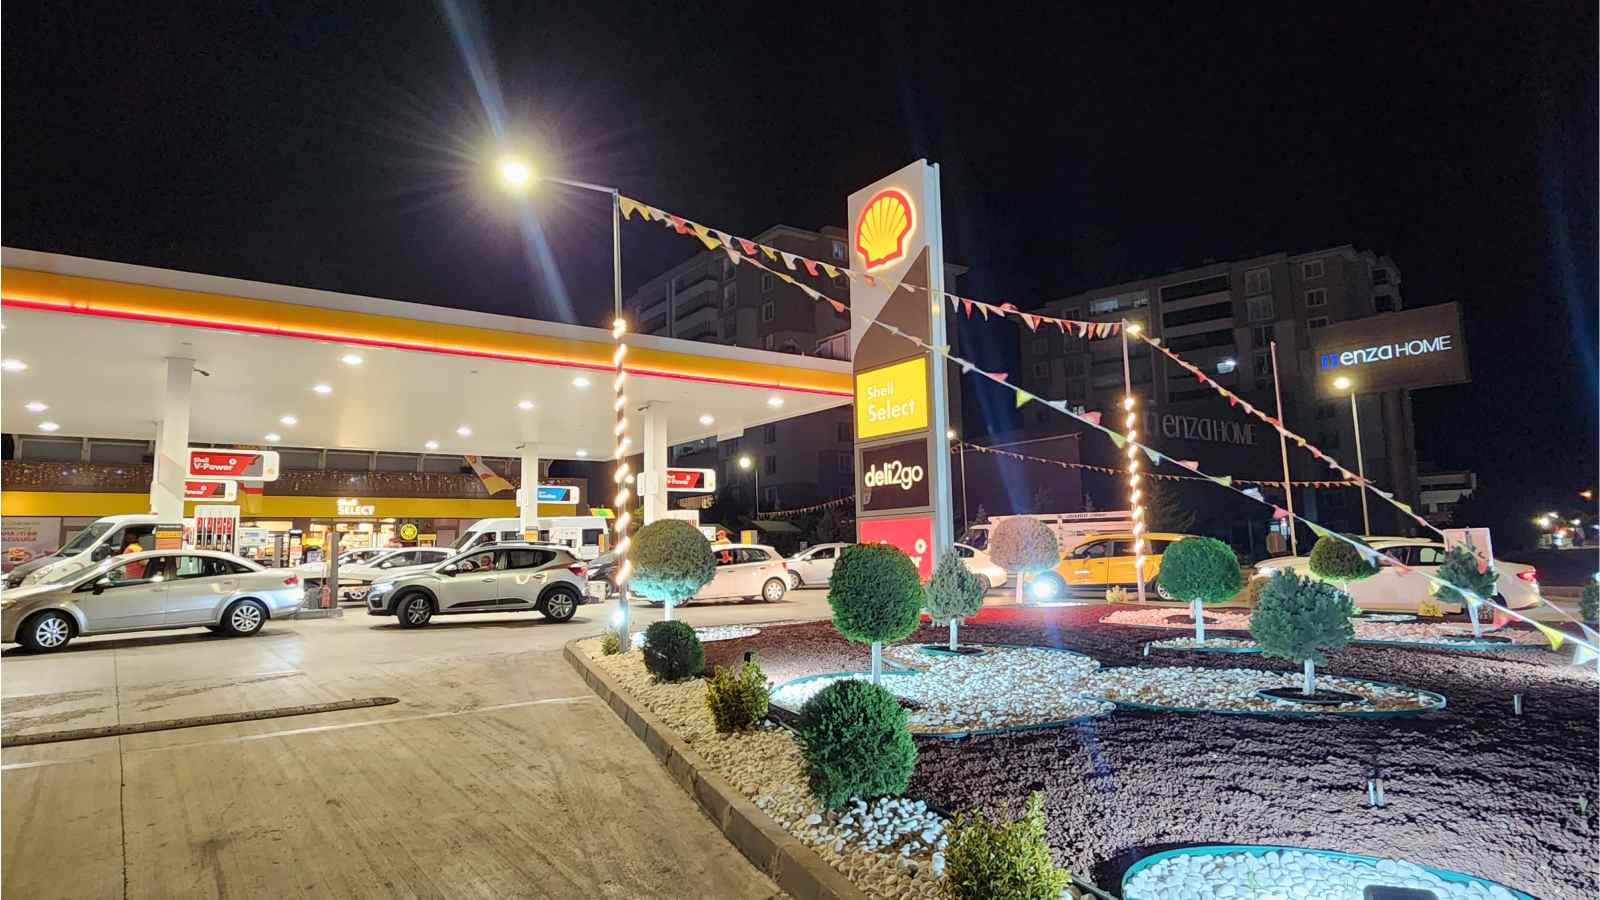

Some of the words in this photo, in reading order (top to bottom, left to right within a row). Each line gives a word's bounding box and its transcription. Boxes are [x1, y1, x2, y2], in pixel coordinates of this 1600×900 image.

[1340, 345, 1392, 365] enza
[1395, 335, 1452, 358] HOME
[867, 379, 894, 400] Shell
[868, 399, 916, 422] Select
[1162, 413, 1212, 441] enza
[1213, 418, 1258, 445] HOME
[864, 460, 924, 490] deli2go
[337, 505, 375, 516] SELECT
